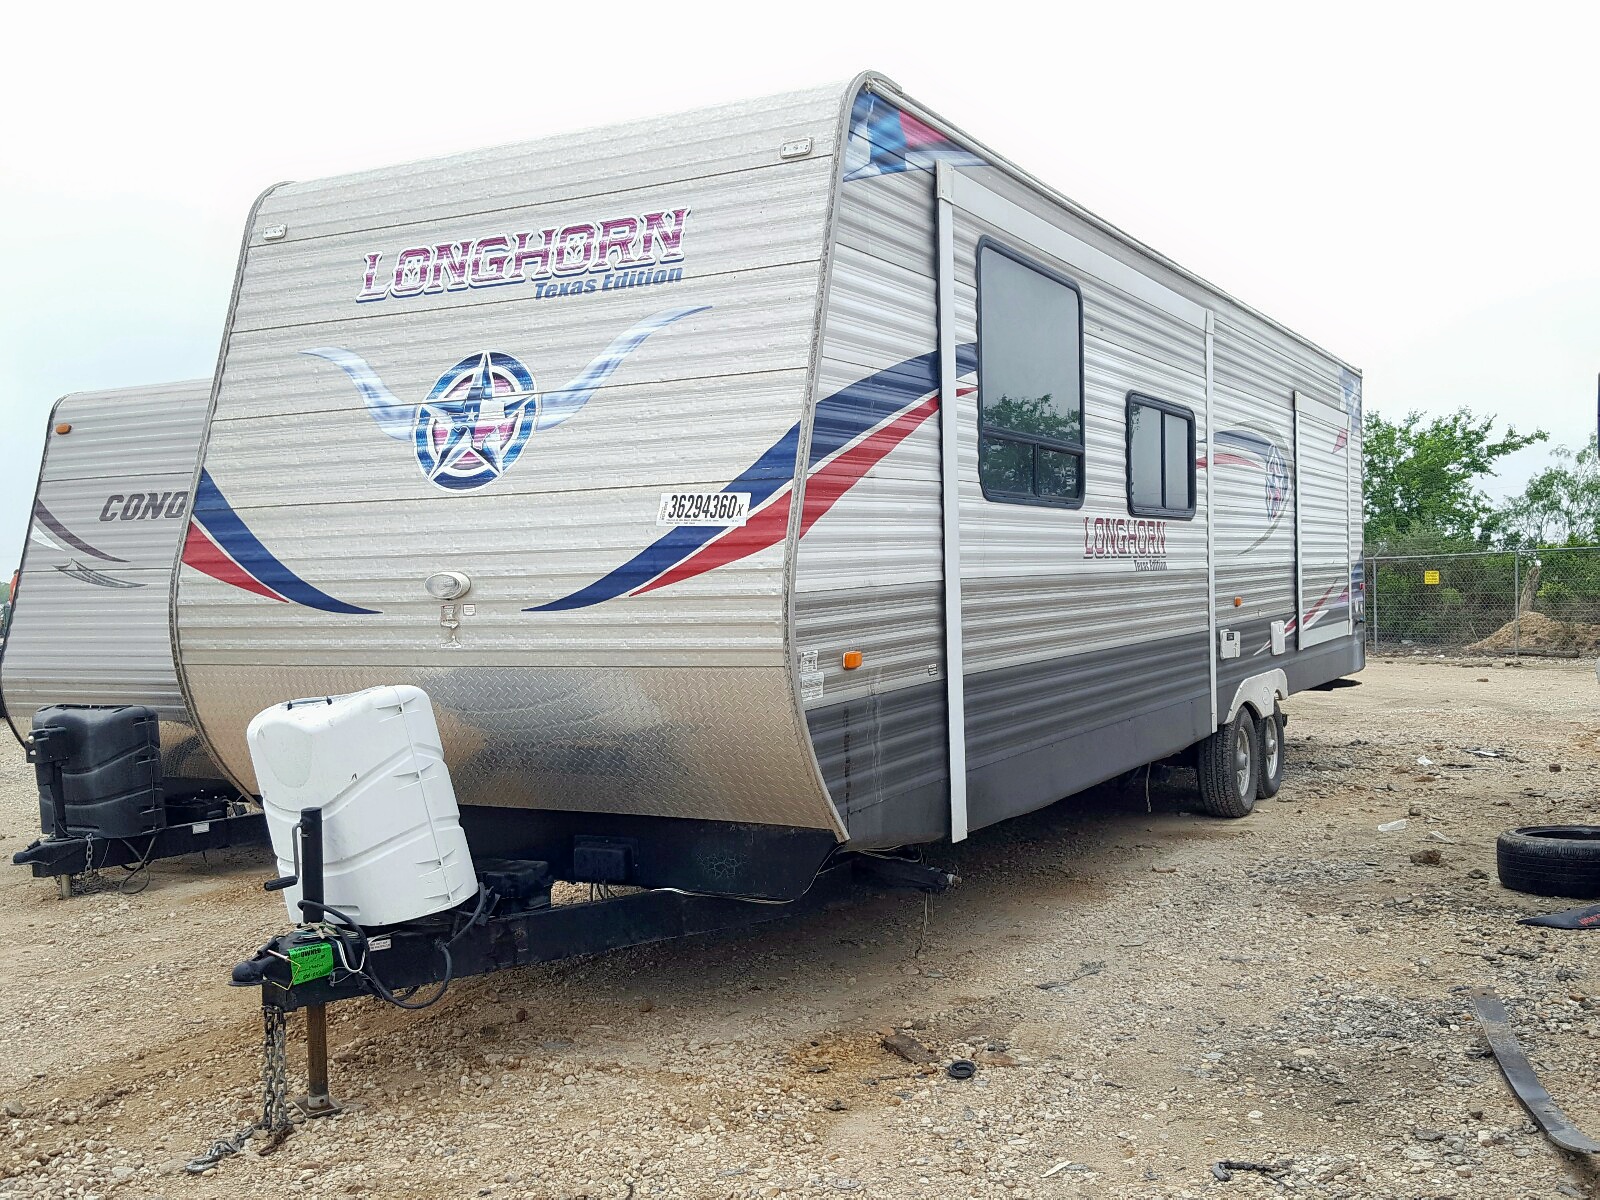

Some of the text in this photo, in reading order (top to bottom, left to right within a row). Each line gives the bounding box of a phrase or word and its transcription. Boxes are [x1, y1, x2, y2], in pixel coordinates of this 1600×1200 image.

[355, 206, 691, 303] LONGHORN
[535, 266, 684, 300] Texas Edition
[1083, 517, 1167, 559] LONGHORN
